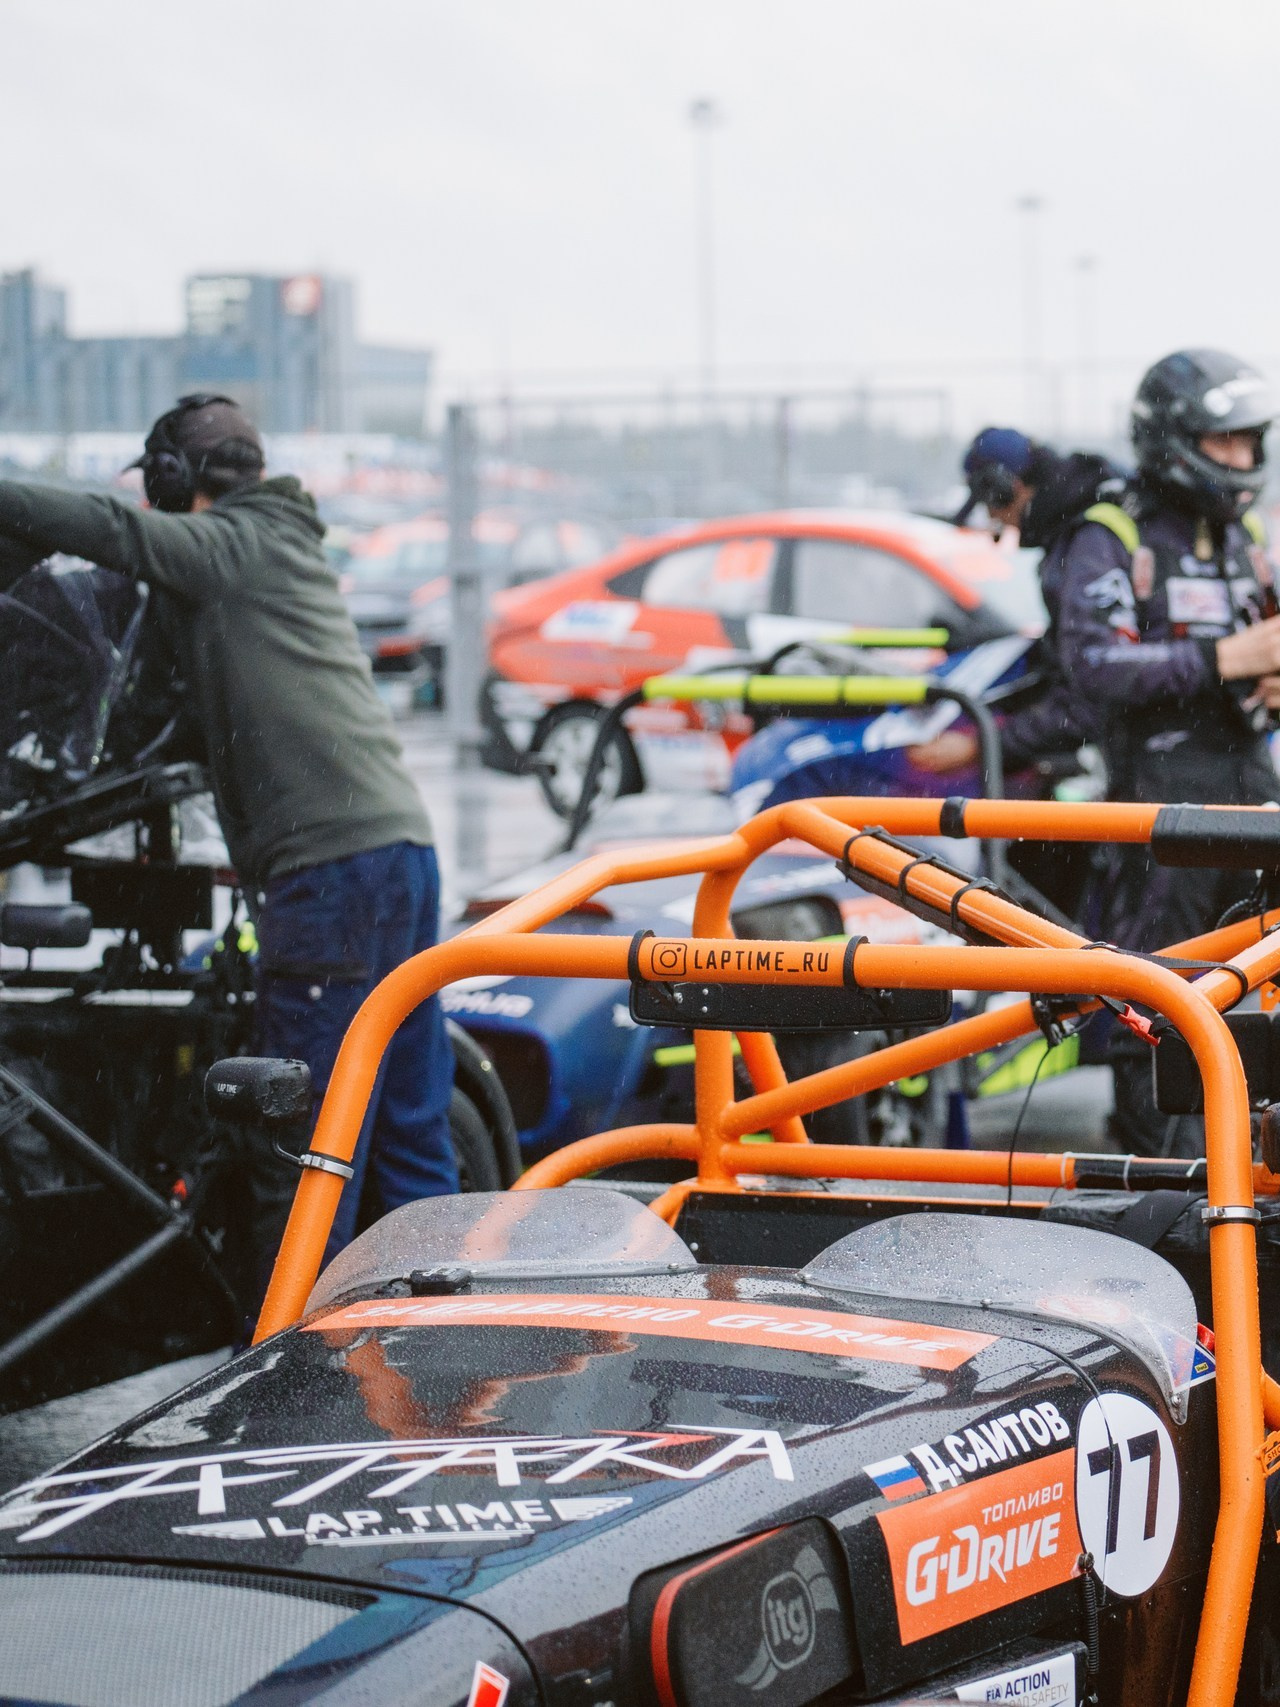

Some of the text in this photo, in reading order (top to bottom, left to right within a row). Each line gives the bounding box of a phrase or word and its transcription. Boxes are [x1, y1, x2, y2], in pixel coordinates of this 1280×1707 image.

[694, 950, 830, 973] LAPTIME_RU
[217, 1083, 238, 1094] LAP TIME
[981, 1482, 1064, 1526] ТОПЛИВО
[1086, 1429, 1162, 1556] 77
[267, 1499, 553, 1537] LAP TIME
[767, 1594, 809, 1646] itg
[1004, 1669, 1051, 1699] ACTION
[1032, 1682, 1070, 1707] SAFETY
